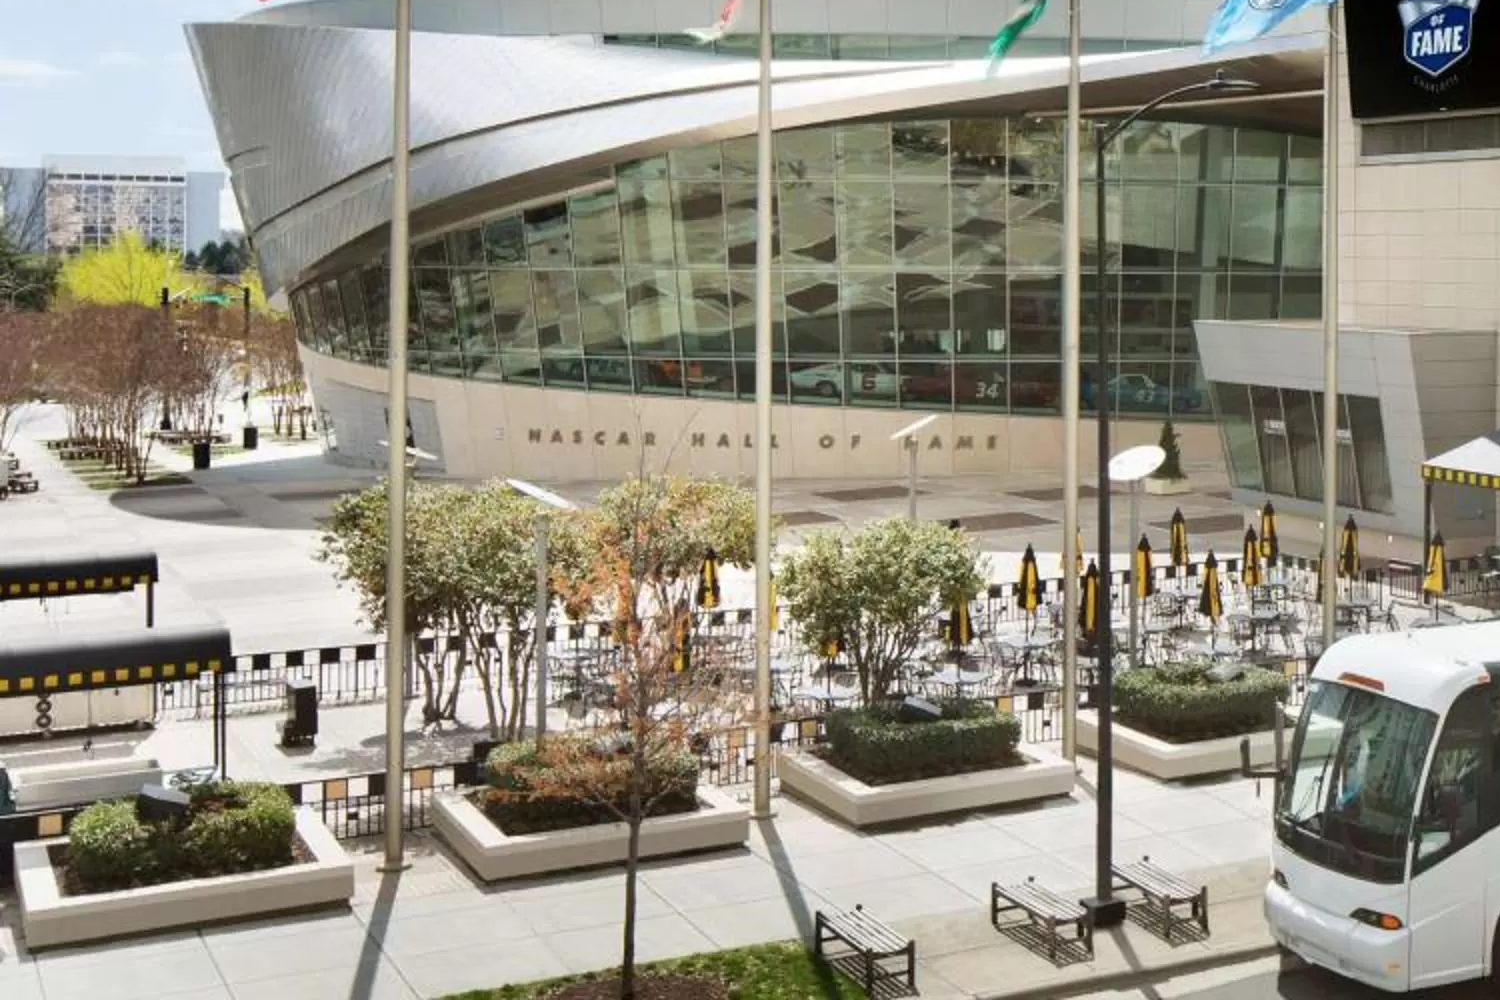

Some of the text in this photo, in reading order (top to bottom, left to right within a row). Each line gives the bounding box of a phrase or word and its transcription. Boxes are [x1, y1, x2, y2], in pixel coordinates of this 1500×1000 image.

[1430, 14, 1445, 26] OF
[1411, 25, 1464, 58] FAME
[528, 428, 657, 447] NASCAR
[691, 432, 780, 449] HALL
[819, 434, 861, 449] OF
